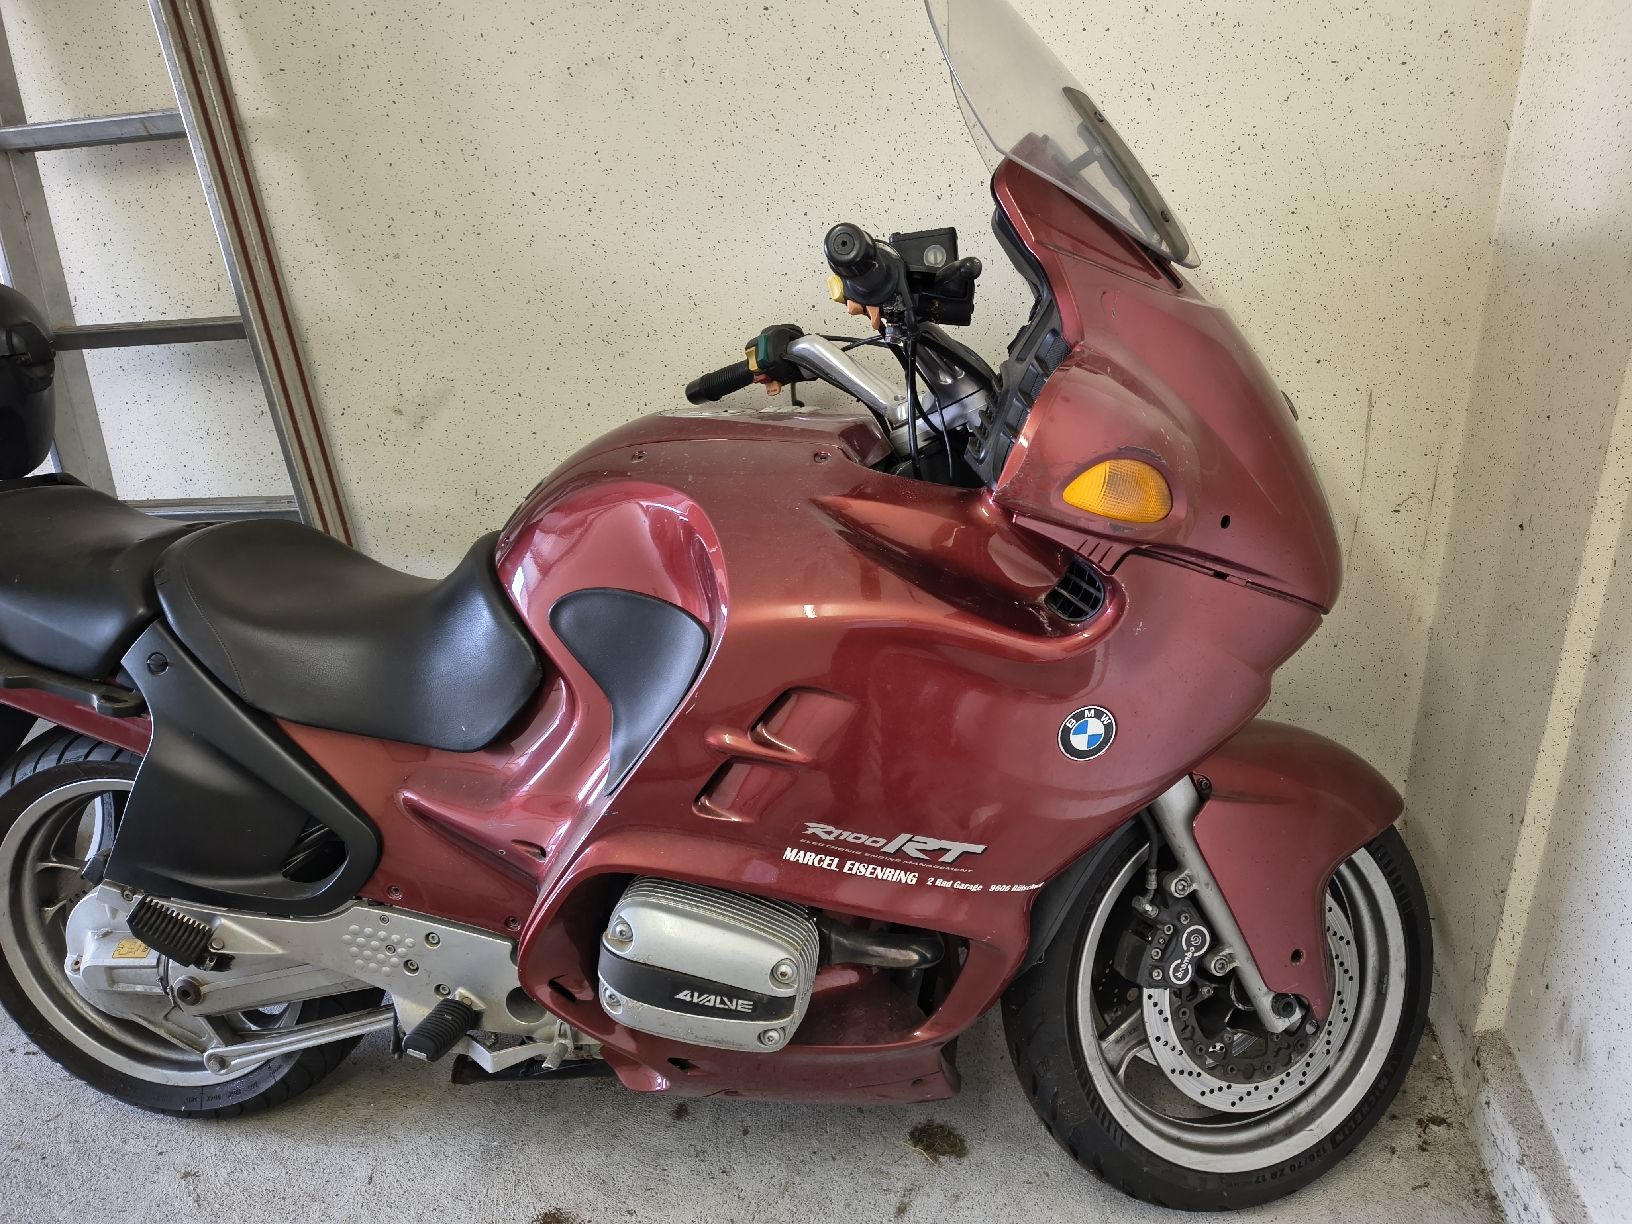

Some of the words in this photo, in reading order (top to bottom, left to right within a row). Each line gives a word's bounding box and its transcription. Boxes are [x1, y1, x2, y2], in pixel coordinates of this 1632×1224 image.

[1066, 708, 1111, 728] BMW
[783, 847, 840, 871] MARCEL
[843, 860, 919, 885] EISENRING
[926, 877, 934, 886] 2
[935, 878, 953, 888] Rad
[953, 880, 983, 892] Garage
[1175, 946, 1195, 978] brembo
[1333, 1075, 1389, 1144] MICHELIN
[1289, 1146, 1327, 1172] 120/70
